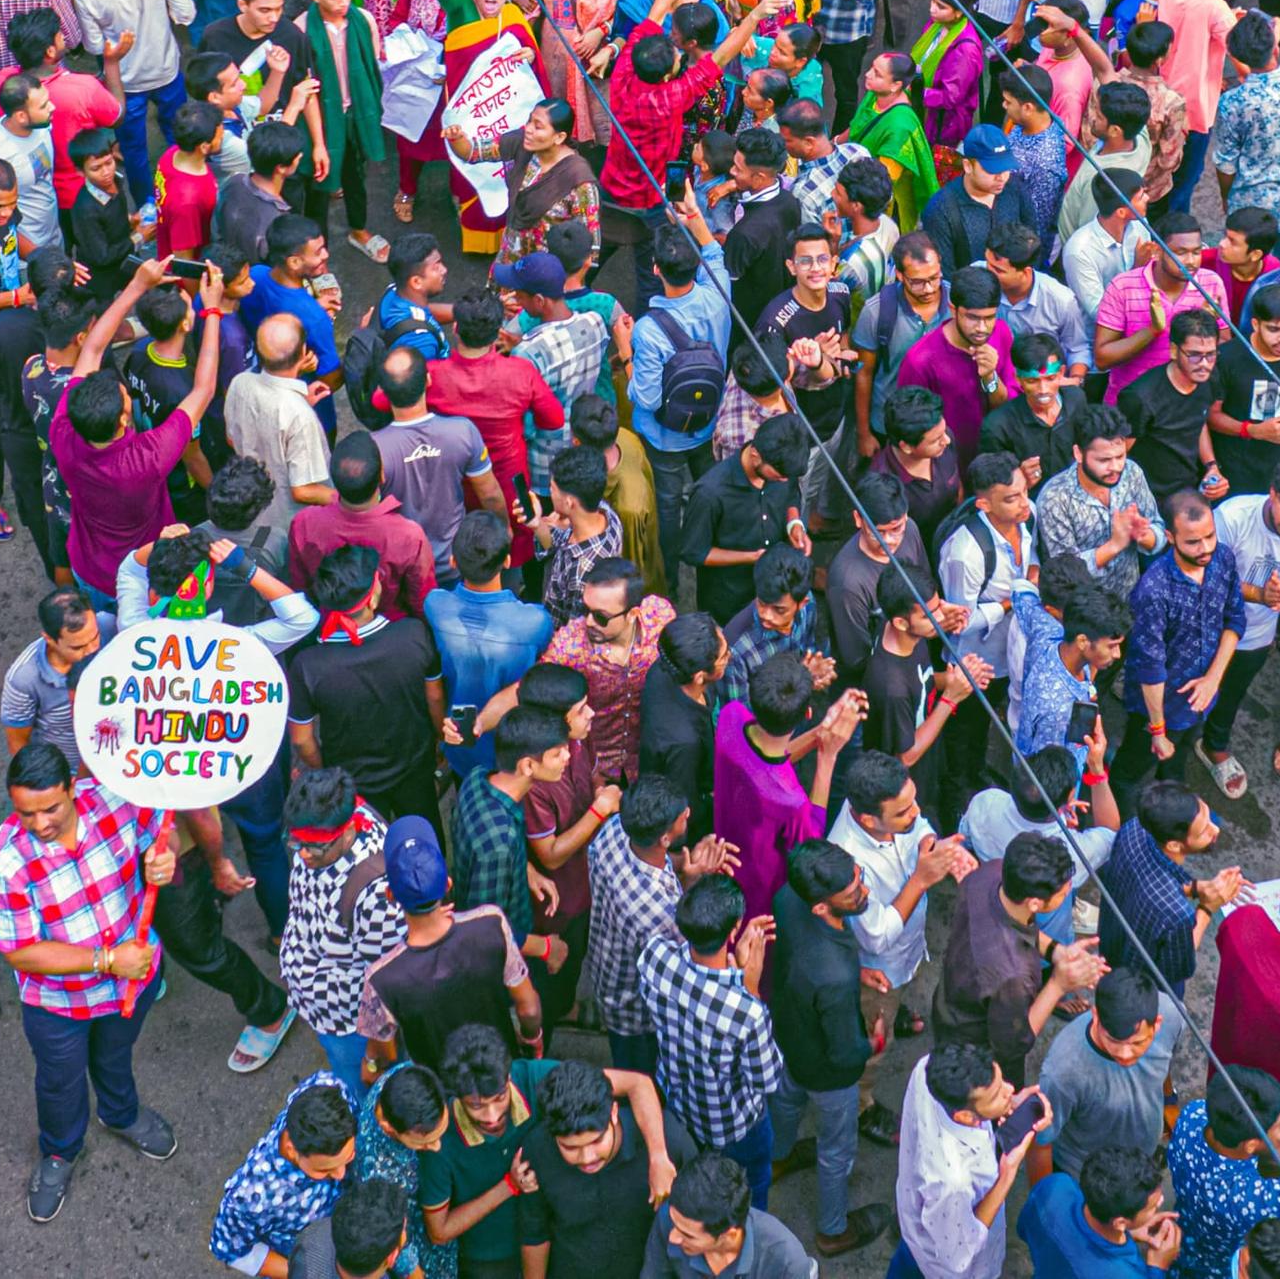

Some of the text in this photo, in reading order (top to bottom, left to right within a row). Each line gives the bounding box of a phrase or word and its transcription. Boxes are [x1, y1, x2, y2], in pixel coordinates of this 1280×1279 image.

[132, 634, 240, 671] SAVE
[99, 676, 283, 705] BANGLADESH
[135, 707, 249, 744] HINDU
[122, 749, 253, 782] SOCIETY
